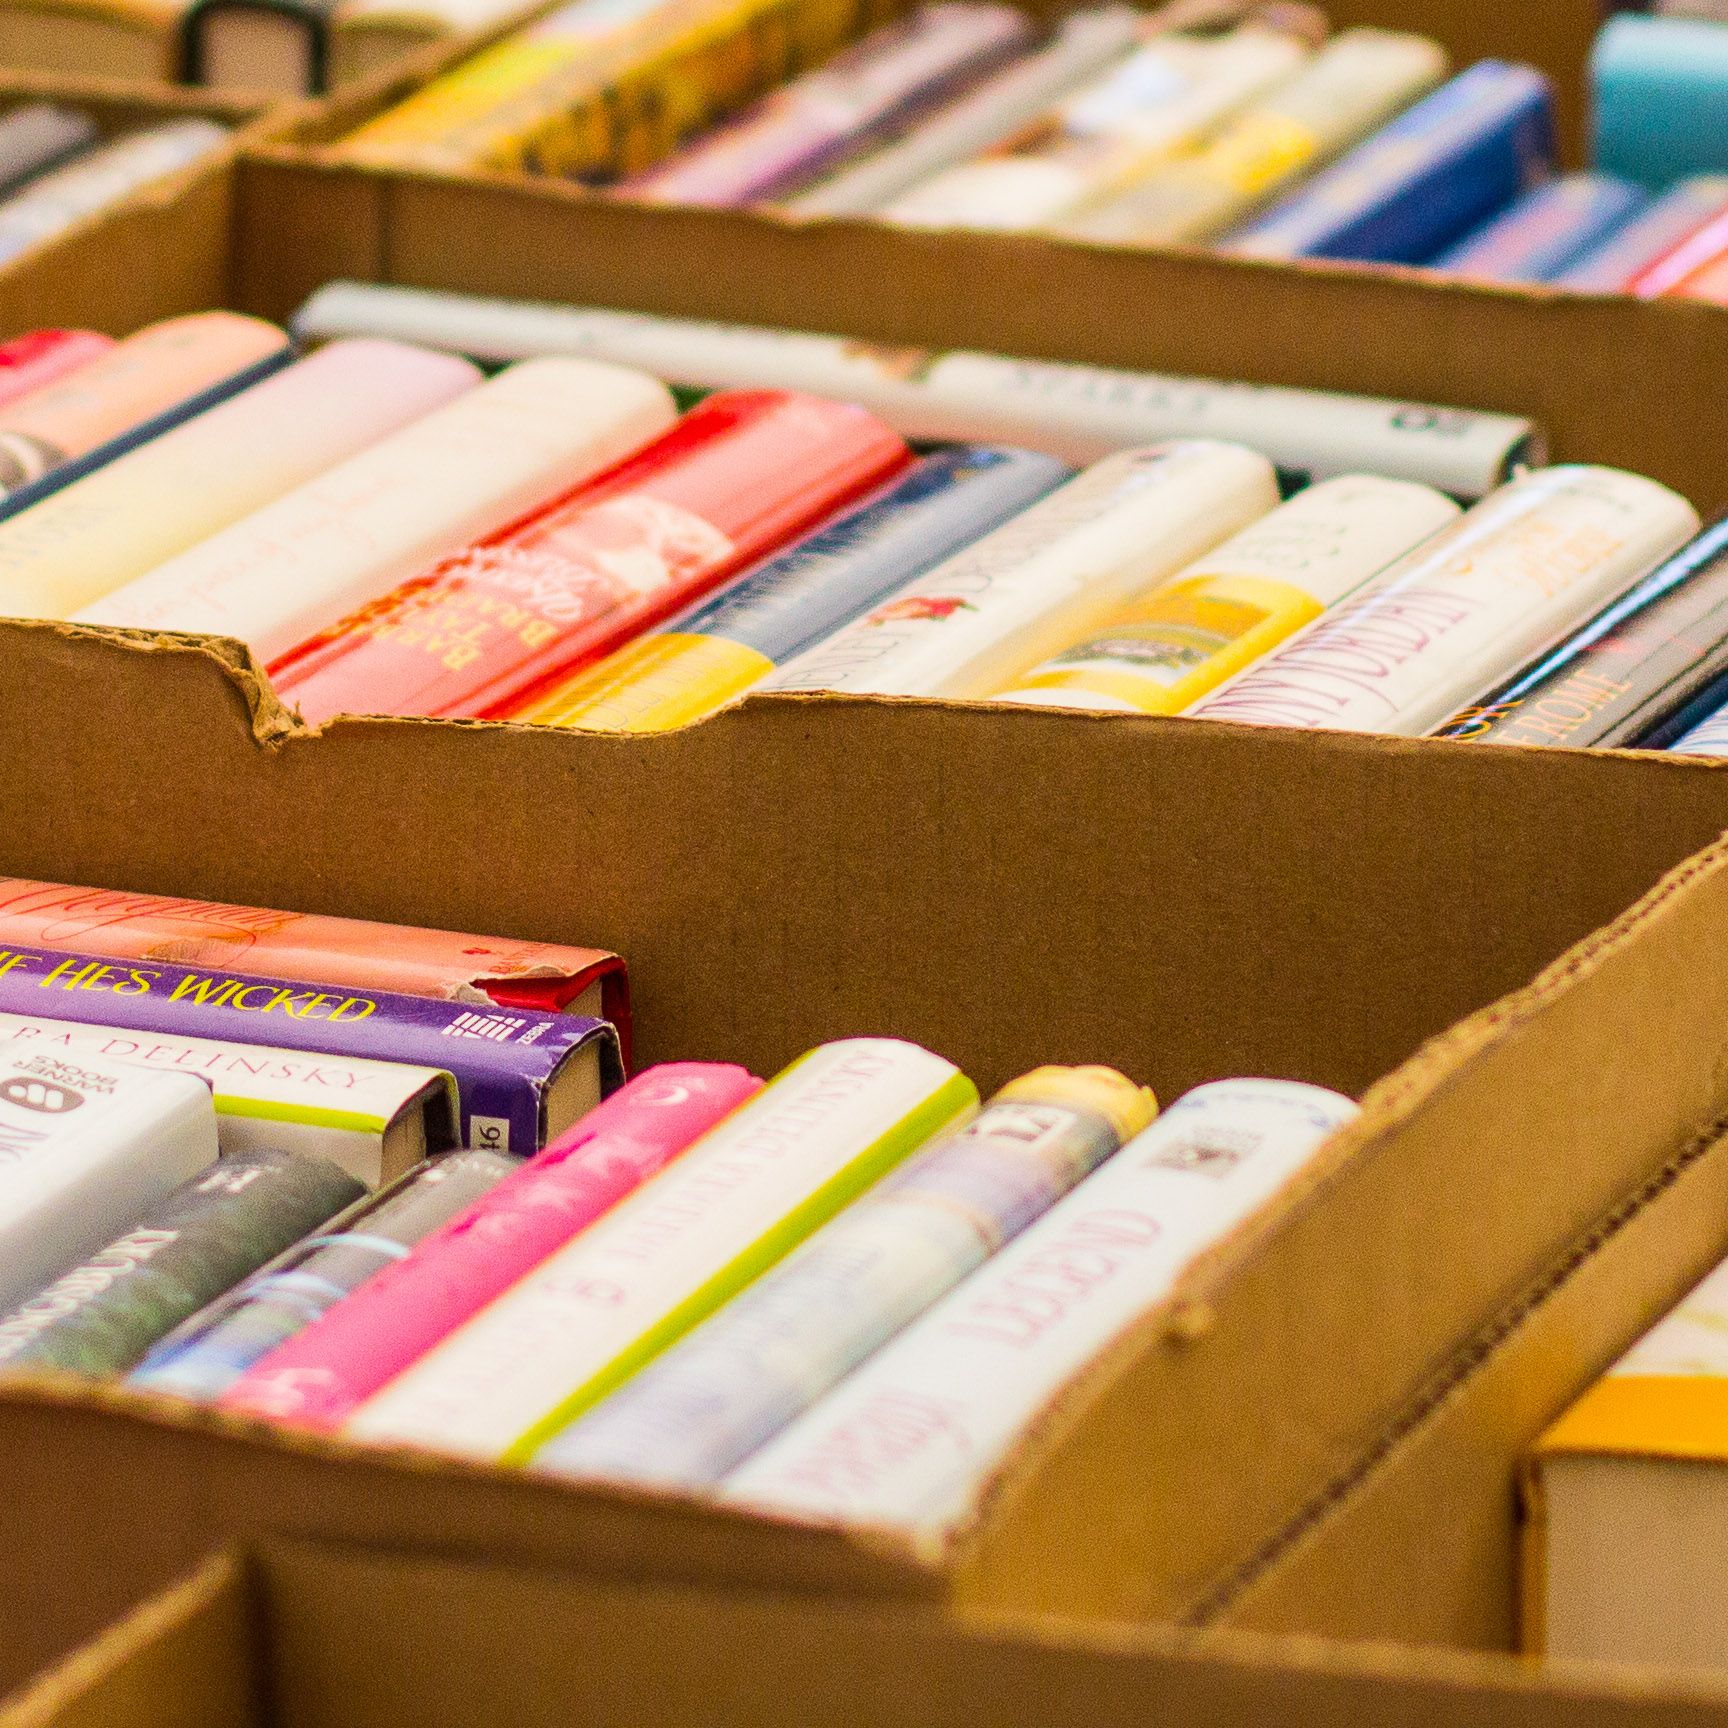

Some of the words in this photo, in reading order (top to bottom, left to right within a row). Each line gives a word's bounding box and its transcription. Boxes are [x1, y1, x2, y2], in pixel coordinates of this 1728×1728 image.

[168, 972, 378, 1024] WICKED
[13, 1057, 115, 1096] WARNER
[33, 1053, 120, 1085] BOOKS
[98, 1038, 377, 1090] DELINSKY
